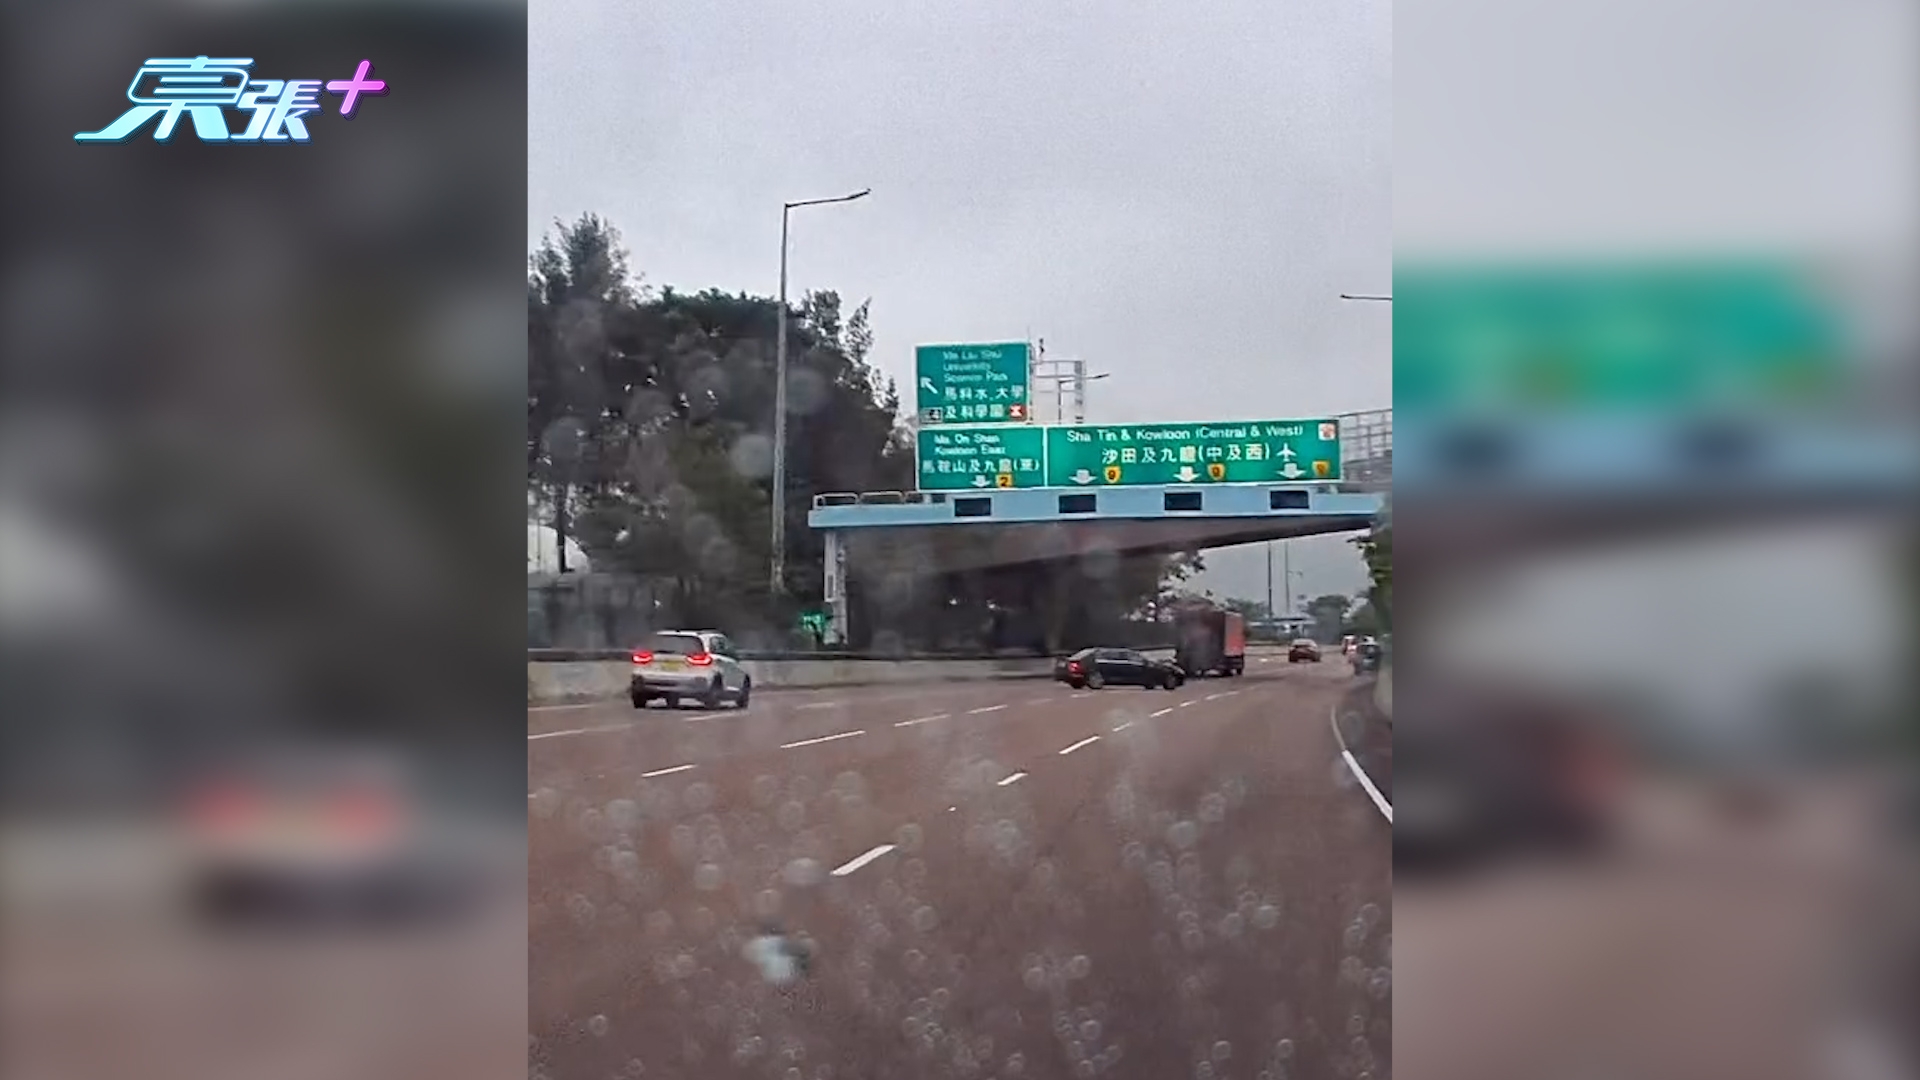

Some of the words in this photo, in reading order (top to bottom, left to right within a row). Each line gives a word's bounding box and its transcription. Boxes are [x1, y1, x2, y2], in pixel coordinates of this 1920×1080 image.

[934, 434, 950, 444] Ma
[954, 433, 970, 444] On
[1066, 430, 1091, 442] Sha
[1097, 428, 1118, 441] Tin
[1121, 428, 1131, 440] &
[1136, 428, 1190, 441] Kowloon
[1195, 426, 1247, 438] (Central
[1250, 425, 1260, 437] &
[1265, 425, 1303, 437] West)
[934, 446, 977, 455] Kowloon
[1108, 469, 1117, 480] 9
[999, 476, 1009, 487] 2
